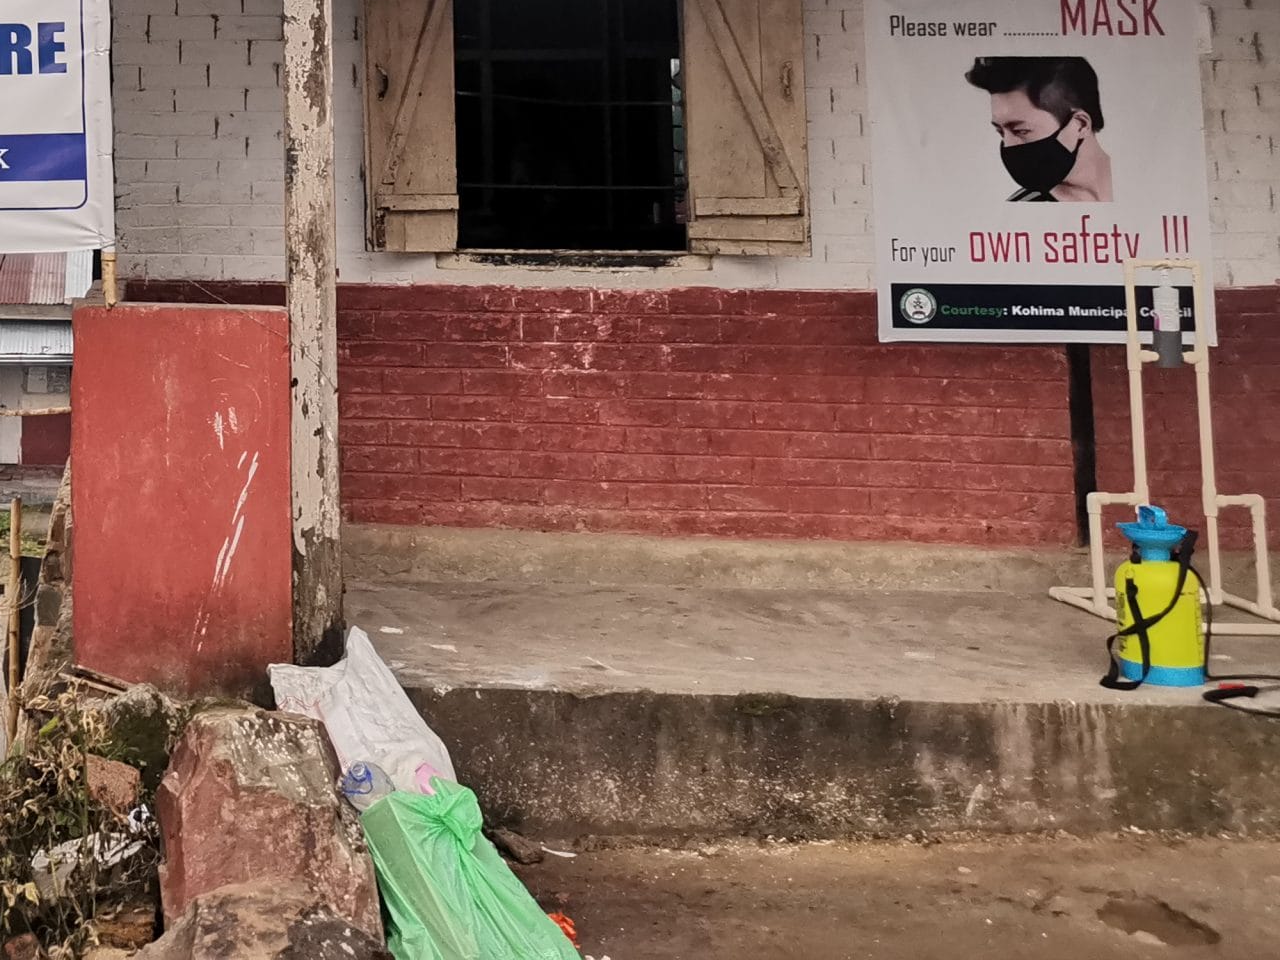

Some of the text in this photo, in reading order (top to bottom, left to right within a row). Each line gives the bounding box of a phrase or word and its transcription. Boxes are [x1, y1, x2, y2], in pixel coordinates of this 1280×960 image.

[890, 15, 947, 37] Please
[953, 20, 997, 37] wear
[891, 238, 917, 263] For
[921, 244, 956, 267] your
[970, 231, 1032, 264] own
[940, 304, 1192, 319] Courtesy: Kohima Municipa Coil
